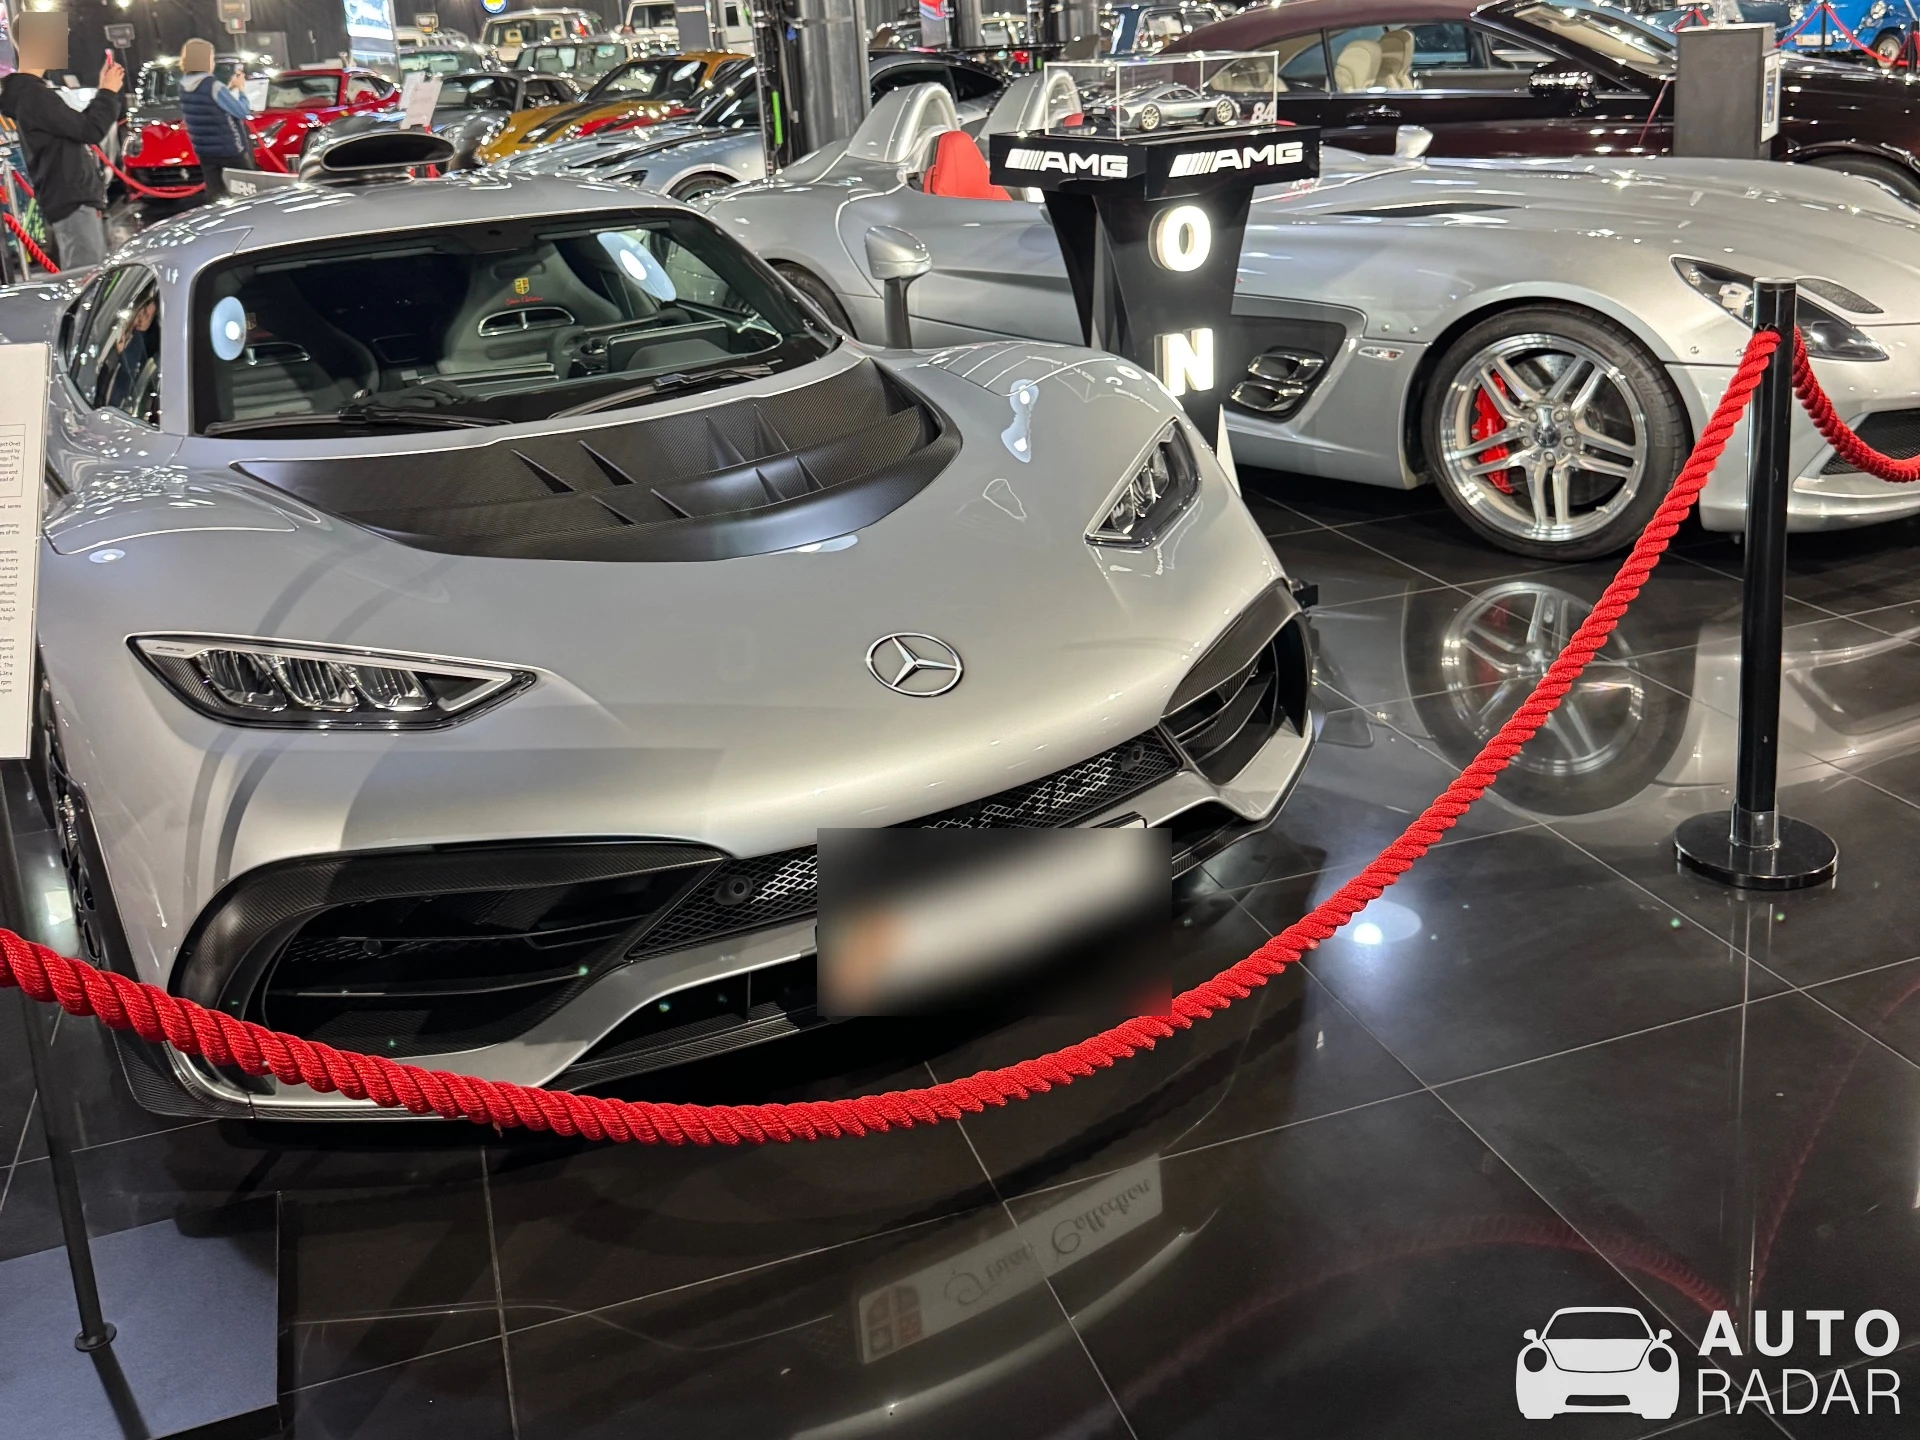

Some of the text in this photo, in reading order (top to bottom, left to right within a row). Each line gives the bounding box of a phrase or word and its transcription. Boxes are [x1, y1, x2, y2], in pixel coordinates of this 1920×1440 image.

[1250, 101, 1277, 125] 84
[1038, 151, 1129, 178] AMG
[1206, 141, 1304, 173] AMG
